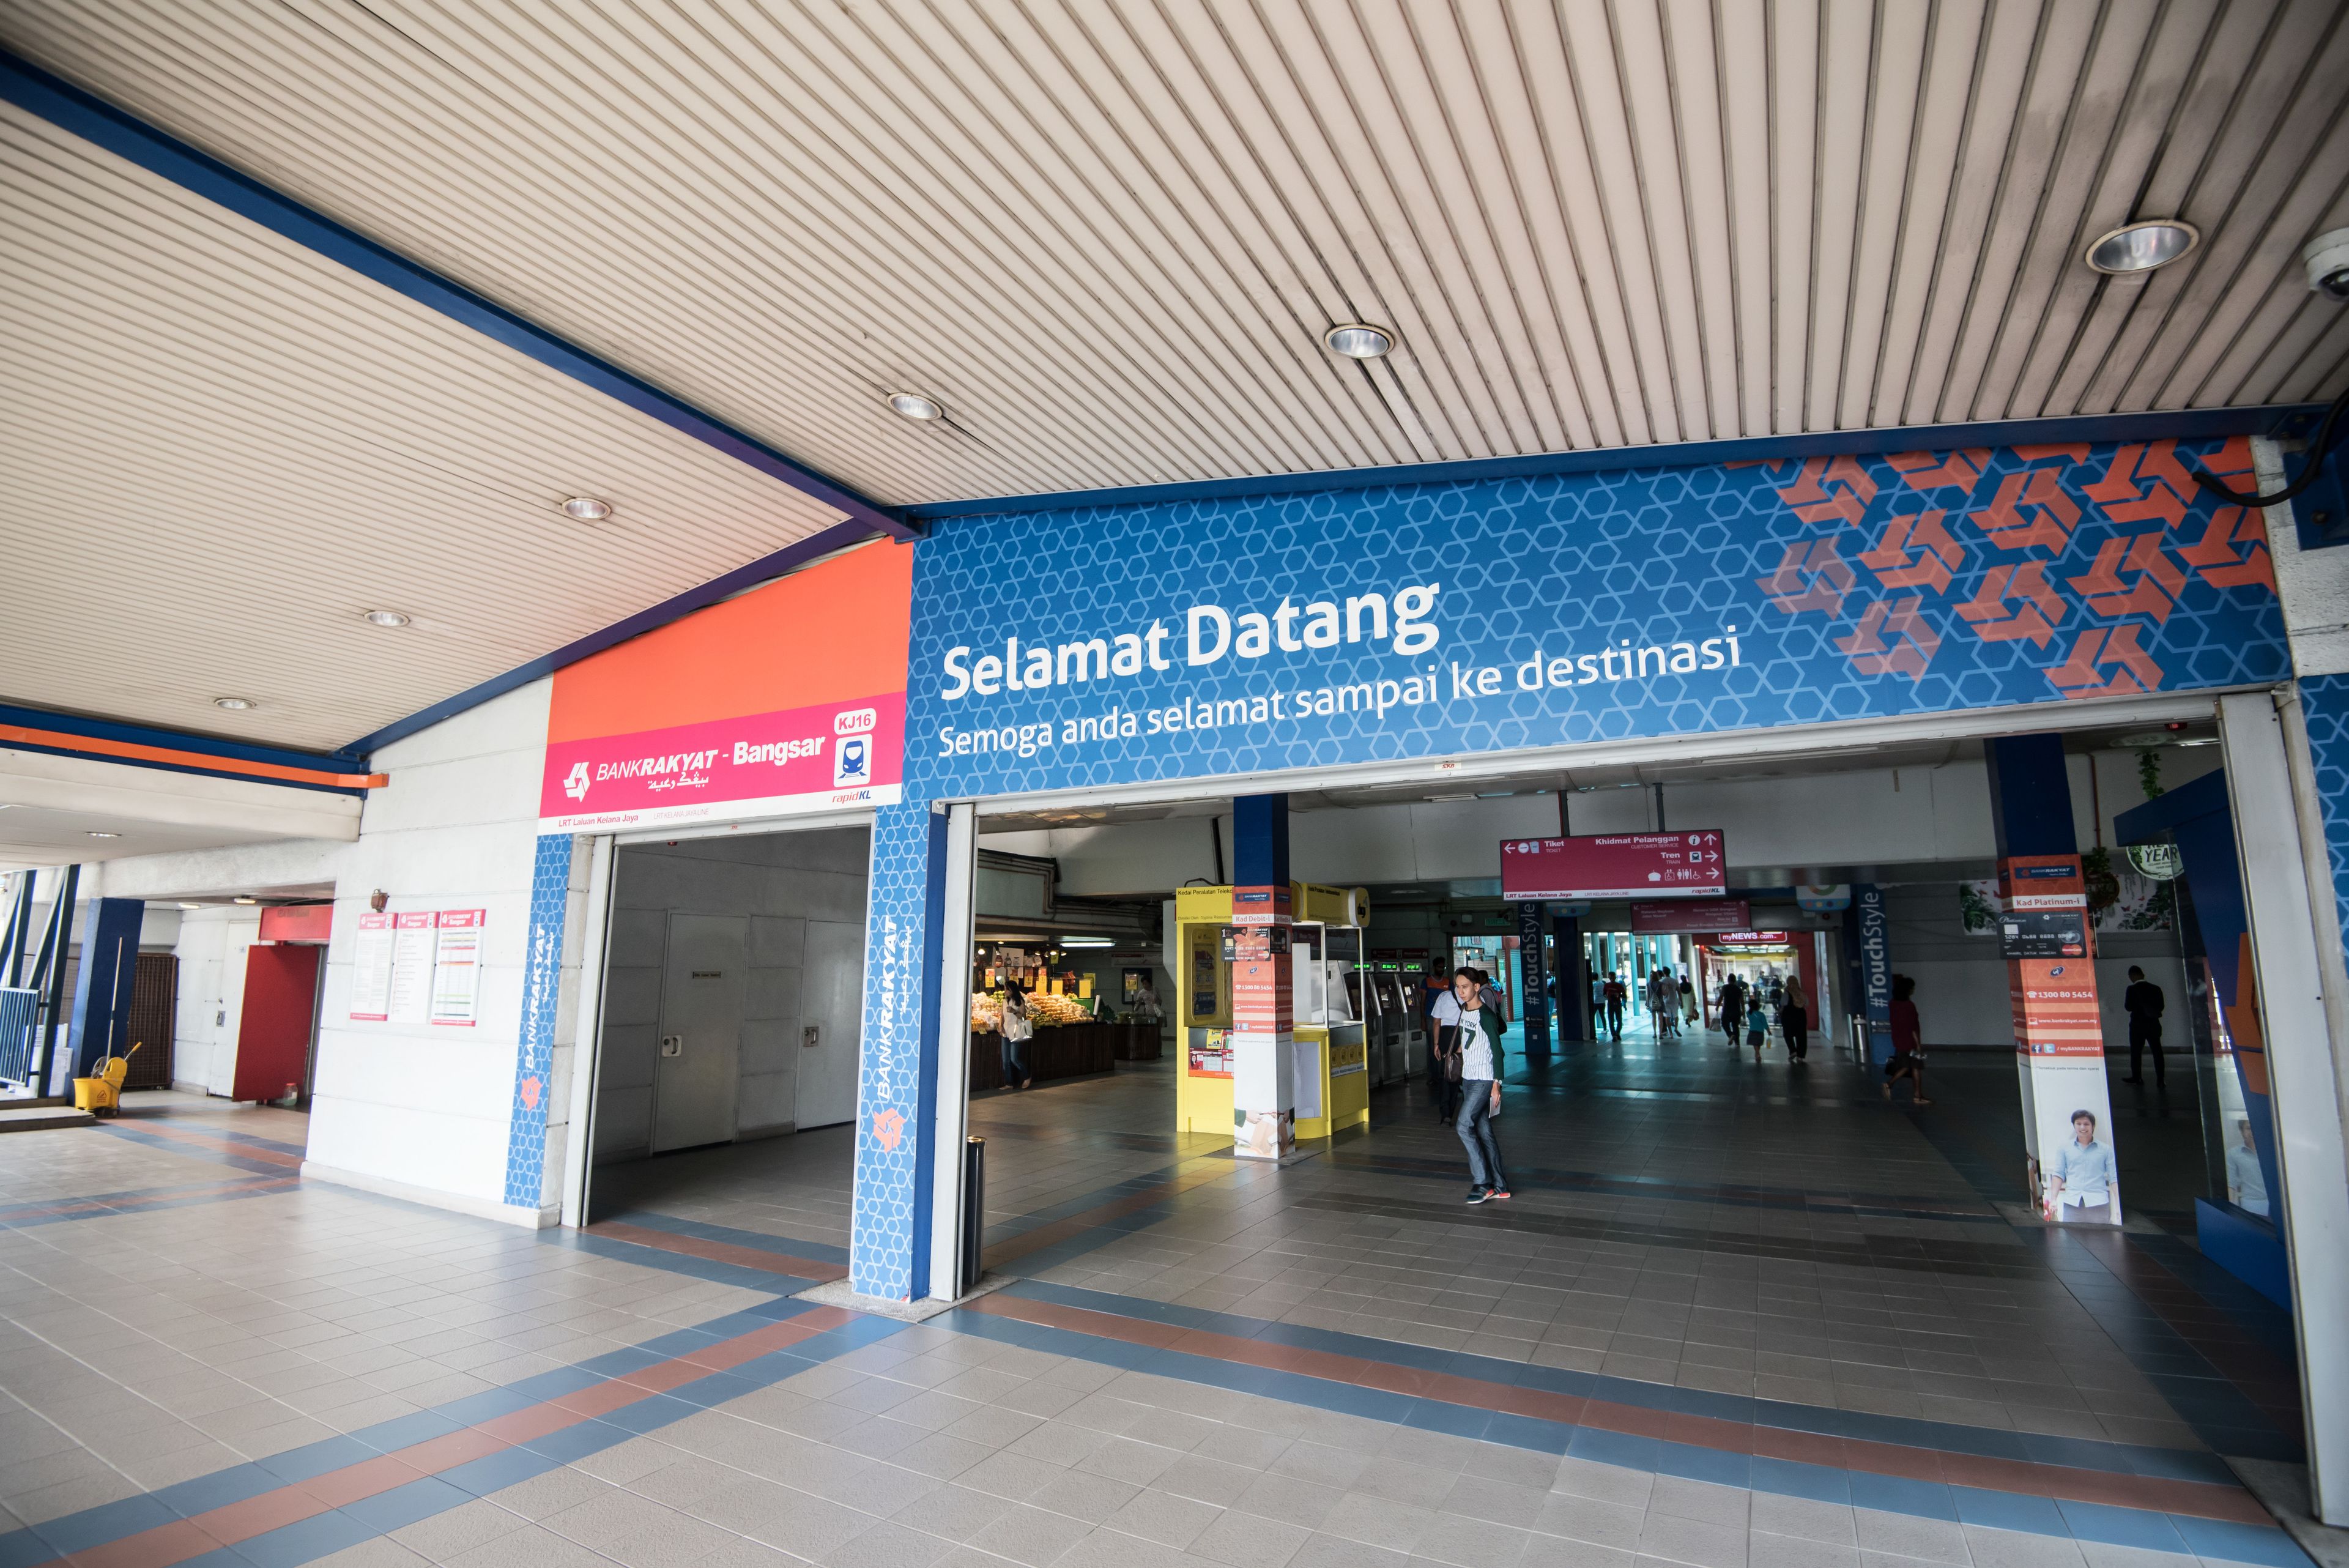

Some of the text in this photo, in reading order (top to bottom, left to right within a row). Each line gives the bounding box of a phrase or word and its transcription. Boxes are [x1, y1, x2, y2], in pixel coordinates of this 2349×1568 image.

[941, 582, 1440, 700] Selamat Datang
[838, 713, 871, 730] KJ16
[938, 625, 1740, 758] Semoga anda selamat sampai ke destinasi
[596, 749, 718, 781] BANKRAKYAT
[733, 735, 826, 767] Bangsar
[558, 814, 639, 827] LRT Laluan Kelana Jaya
[831, 790, 871, 803] rapidKL
[2145, 847, 2178, 863] YEAR
[1521, 904, 1540, 1006] #TouchStyle
[1860, 892, 1888, 1008] #TouchStyle
[525, 924, 546, 1070] BANKRAKYAT
[877, 915, 897, 1100] BANKRAKYAT
[1464, 1020, 1477, 1029] YORK
